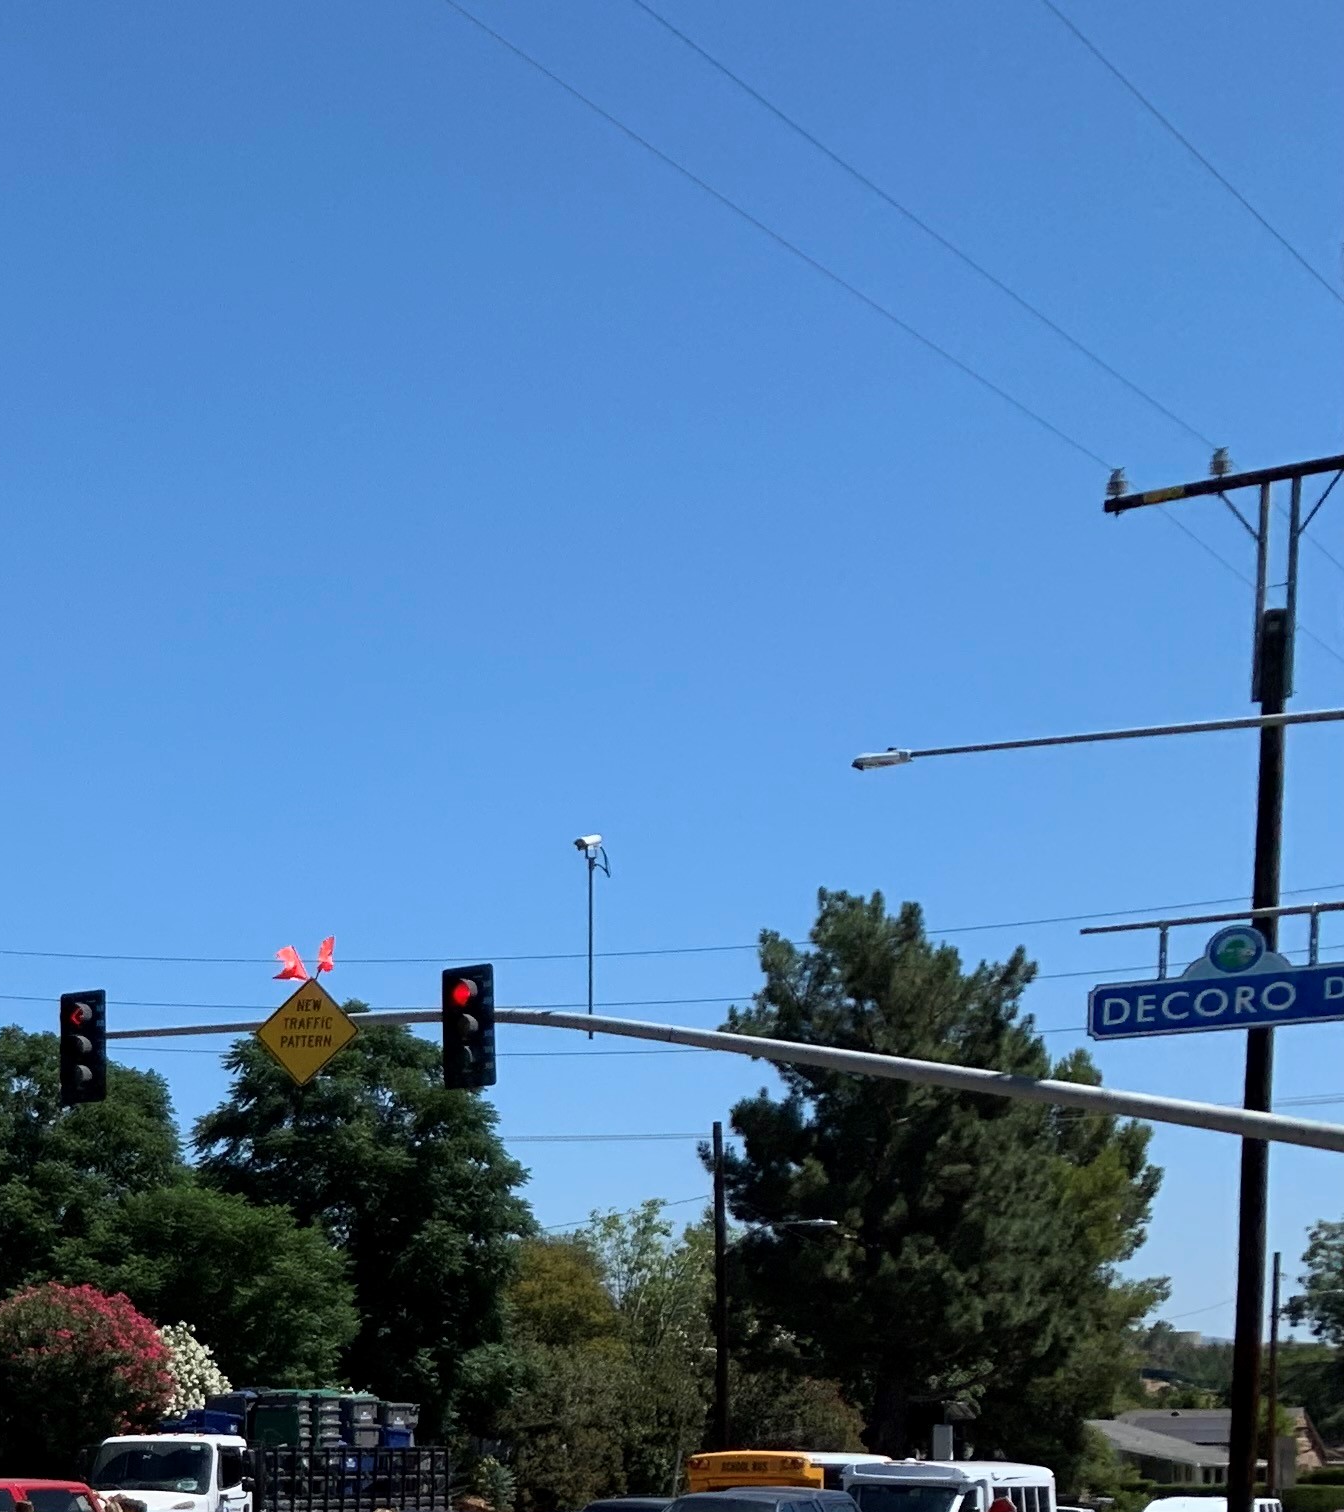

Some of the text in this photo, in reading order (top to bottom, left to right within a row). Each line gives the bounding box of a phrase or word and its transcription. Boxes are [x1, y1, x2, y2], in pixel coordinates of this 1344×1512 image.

[296, 999, 323, 1012] NEW
[1102, 980, 1297, 1027] DECORO
[283, 1015, 334, 1031] TRAFFIC
[279, 1034, 333, 1049] PATTERN
